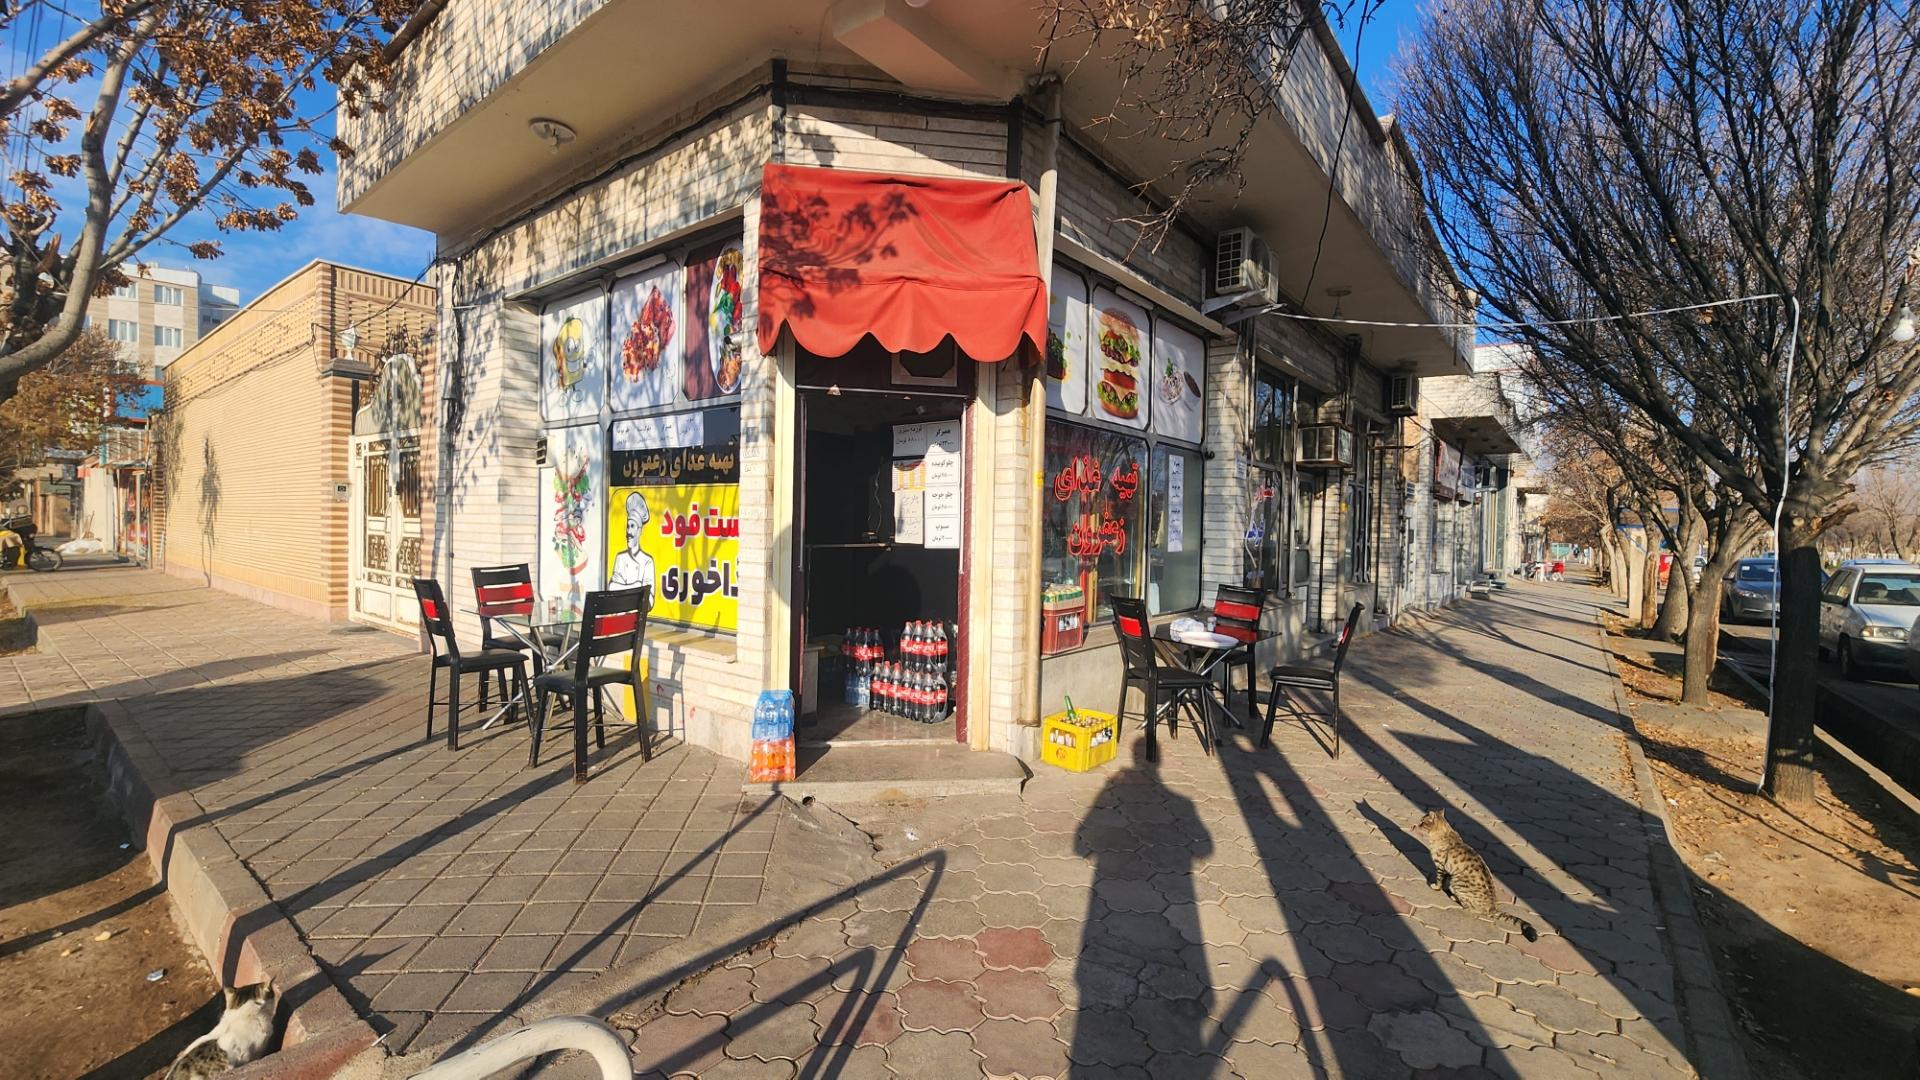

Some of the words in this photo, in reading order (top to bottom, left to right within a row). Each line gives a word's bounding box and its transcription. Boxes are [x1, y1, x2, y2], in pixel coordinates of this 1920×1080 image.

[623, 448, 667, 478] زعفرون
[669, 446, 705, 479] غذای
[708, 440, 734, 481] تهیه
[1054, 456, 1102, 501] غذای
[1110, 462, 1139, 499] تهیه
[661, 504, 701, 548] فود
[704, 508, 740, 538] ست
